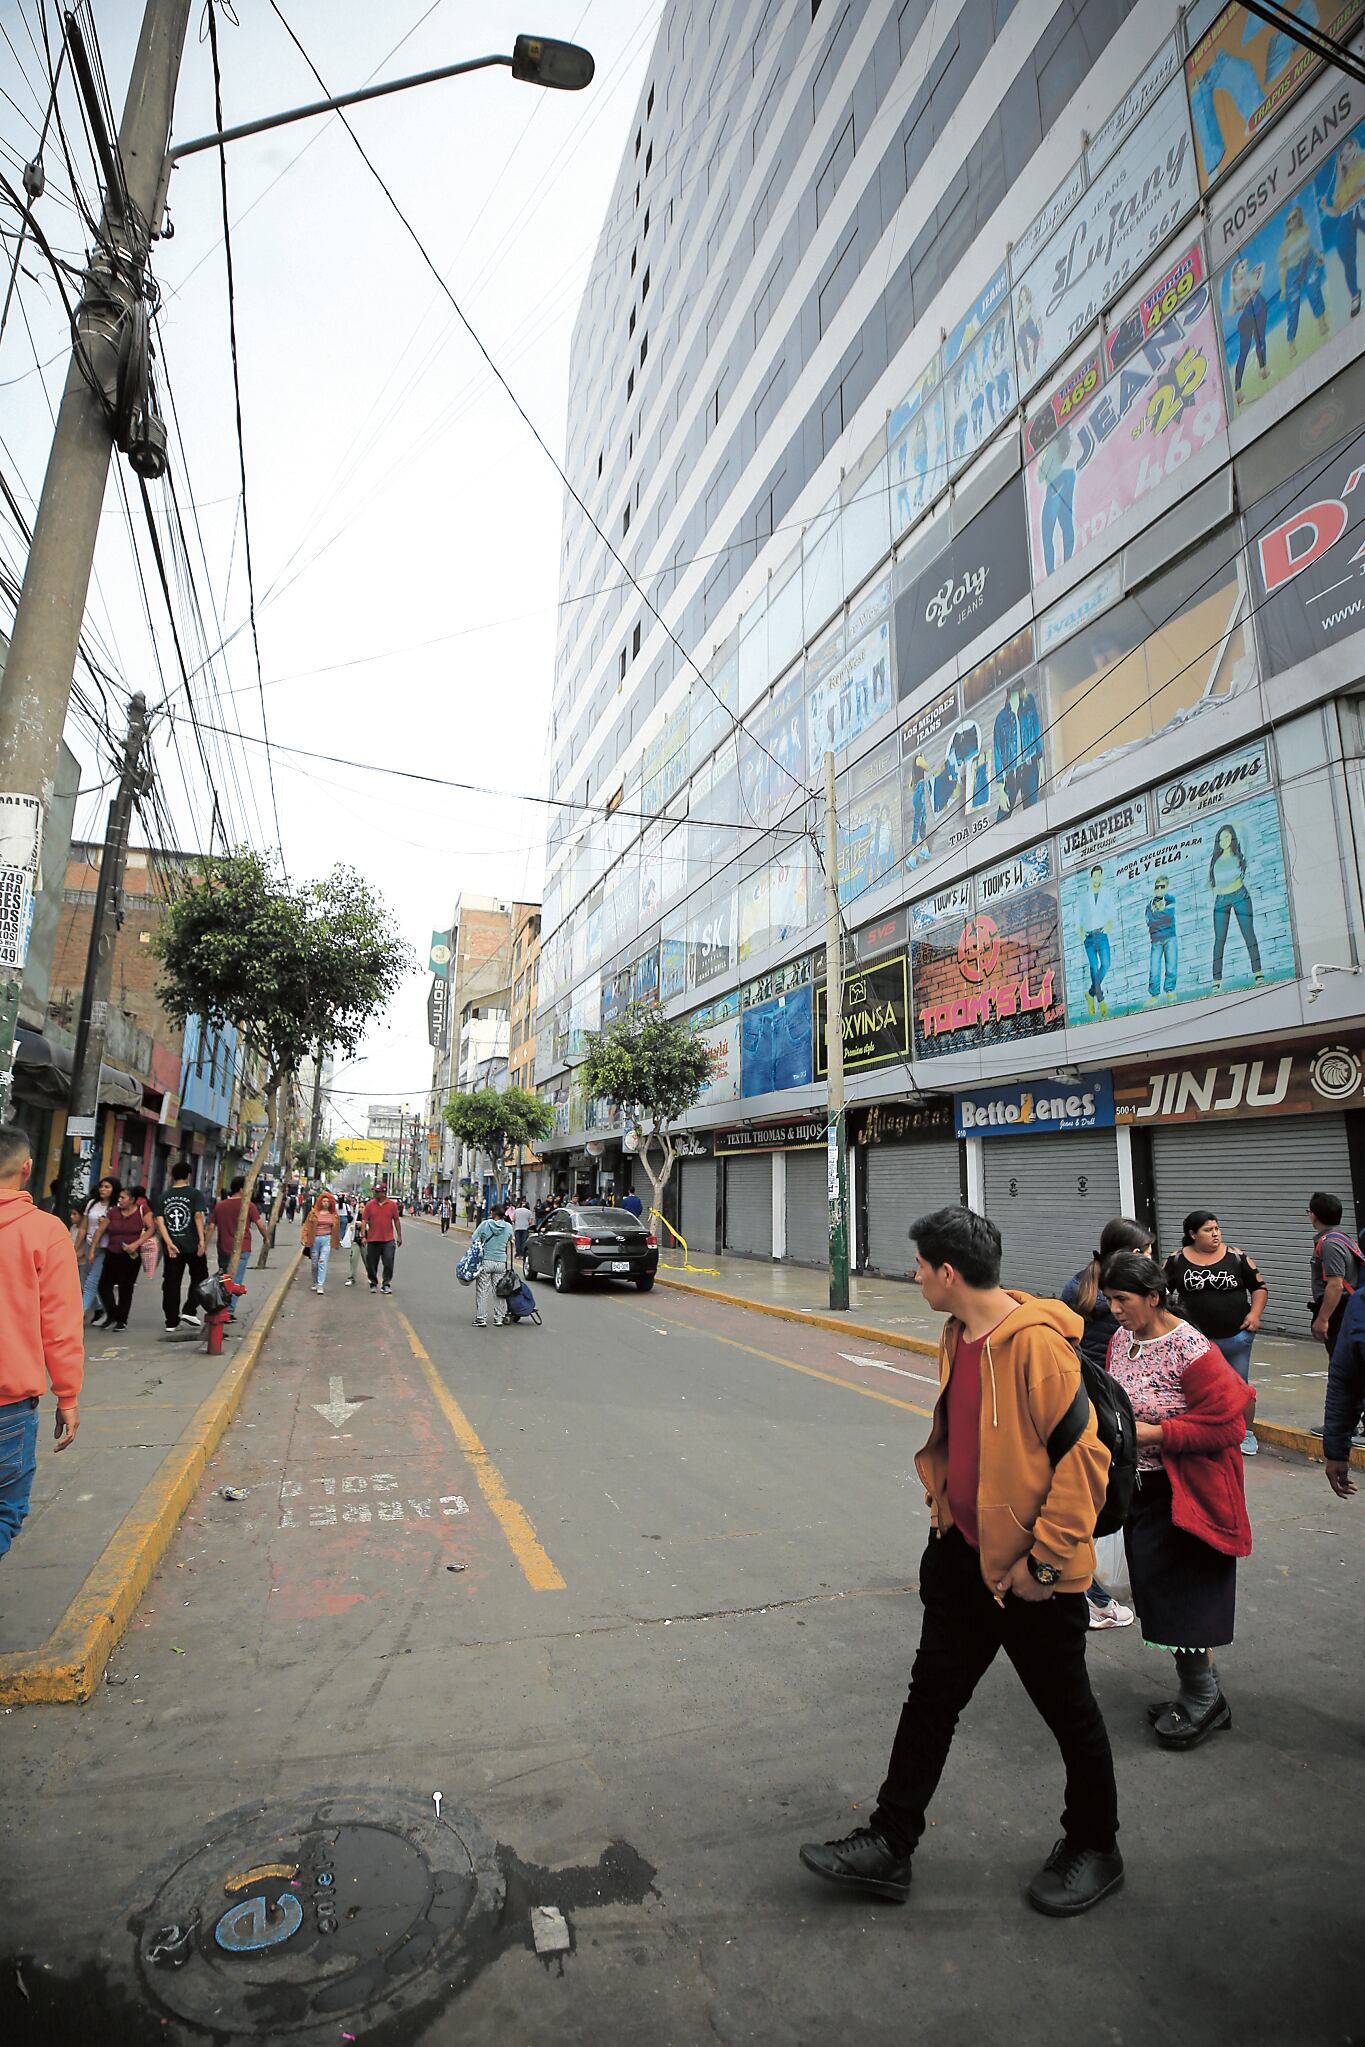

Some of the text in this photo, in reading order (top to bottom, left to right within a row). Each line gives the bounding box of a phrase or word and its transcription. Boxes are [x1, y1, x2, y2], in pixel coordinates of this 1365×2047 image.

[1253, 76, 1292, 126] TRAPOS
[1222, 91, 1352, 244] ROSSY JEANS
[1090, 169, 1128, 220] JEANS
[1115, 188, 1164, 249] PREMIUM
[1102, 258, 1131, 301] 322
[1149, 199, 1182, 248] 567
[1143, 258, 1193, 311] Tienda
[1145, 271, 1195, 331] 469
[1058, 367, 1098, 419] 469
[1147, 345, 1209, 437] 25
[956, 594, 985, 625] JEANS
[903, 695, 956, 742] LOS MEJORES
[916, 718, 943, 746] JEANS
[1161, 756, 1263, 815] Dreams
[1197, 792, 1225, 811] JEANS
[949, 816, 990, 849] TDA 365
[1116, 837, 1203, 877] MODA EXCLUSIVA PARA
[1128, 868, 1142, 881] EL
[1154, 852, 1182, 868] ELLA
[432, 979, 444, 1034] JULIOS
[1136, 1056, 1294, 1118] JINJU
[727, 1122, 823, 1146] TEXTIL THOMAS & HIJOS
